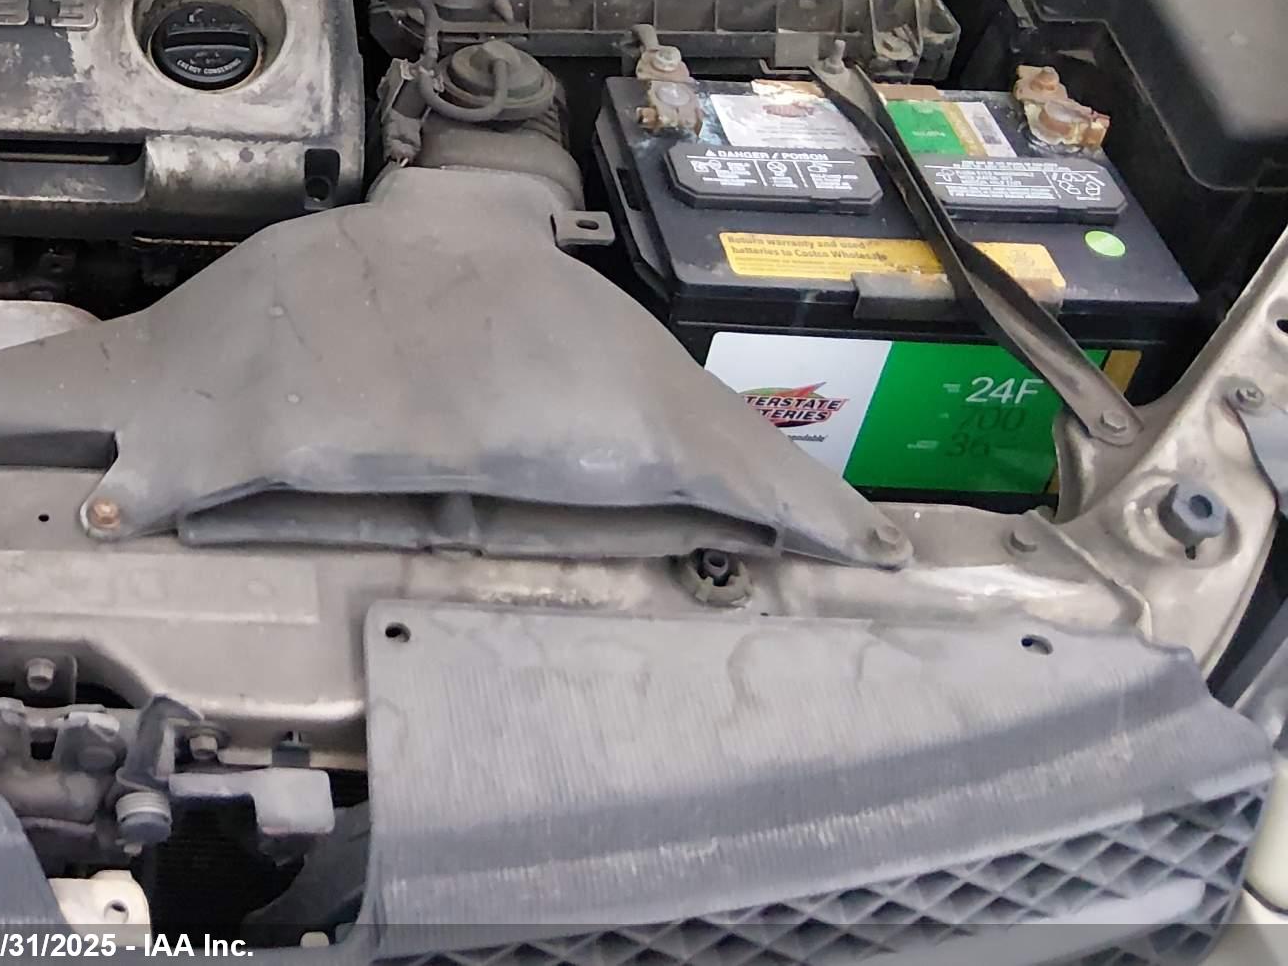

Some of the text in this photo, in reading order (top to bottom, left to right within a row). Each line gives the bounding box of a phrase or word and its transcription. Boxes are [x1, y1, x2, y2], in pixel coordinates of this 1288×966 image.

[717, 150, 770, 160] DANGER
[780, 152, 830, 161] POISON
[727, 235, 866, 249] Return warranty and used
[731, 245, 779, 256] batteries
[781, 247, 793, 256] to
[794, 248, 830, 258] Costco
[965, 376, 1045, 404] 24F
[744, 396, 843, 410] TERSTATE
[760, 409, 828, 421] TERIES
